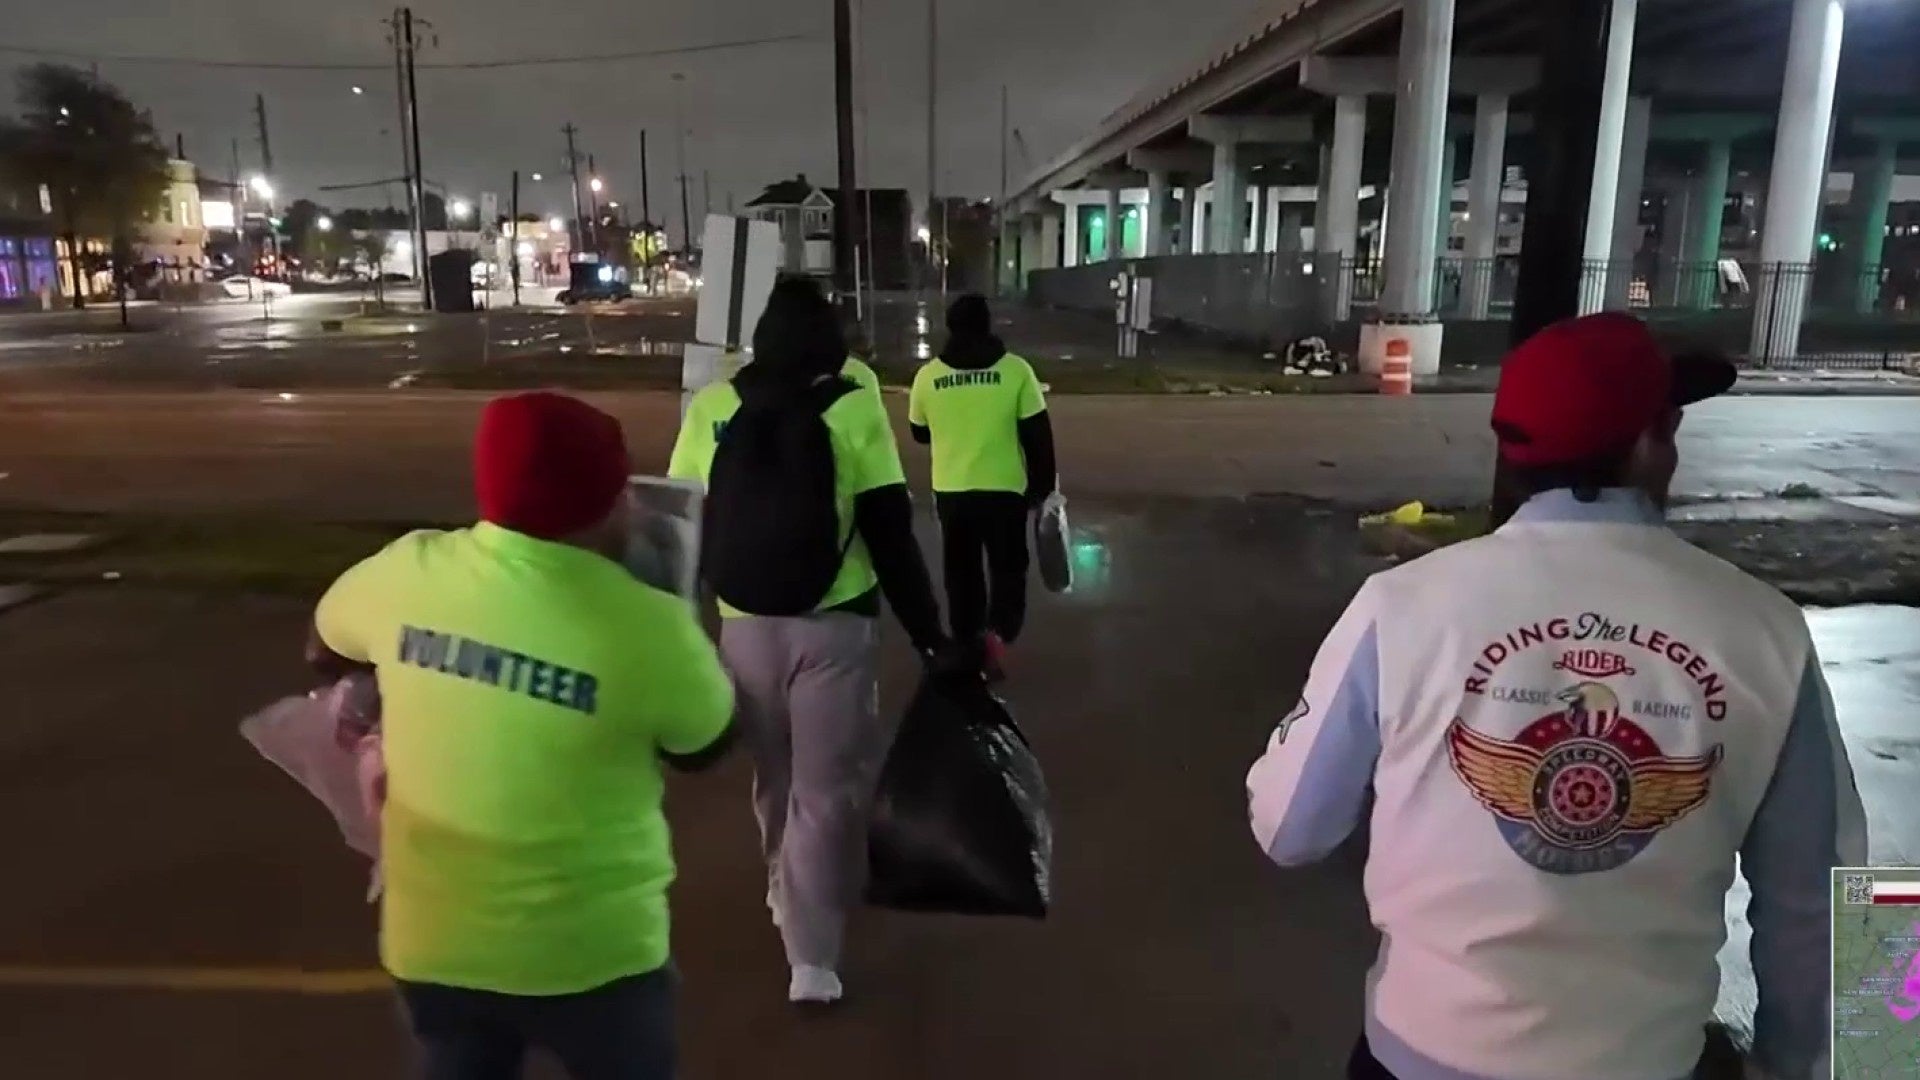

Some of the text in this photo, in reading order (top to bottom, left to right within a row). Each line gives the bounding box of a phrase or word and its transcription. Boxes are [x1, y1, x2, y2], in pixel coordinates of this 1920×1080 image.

[933, 370, 1002, 390] VOLUNTEER
[398, 624, 599, 714] VOLUNTEER
[1464, 611, 1727, 722] RIDING The LEGEND
[1557, 648, 1630, 673] RIDER
[1491, 685, 1692, 720] CLASSIC RACING
